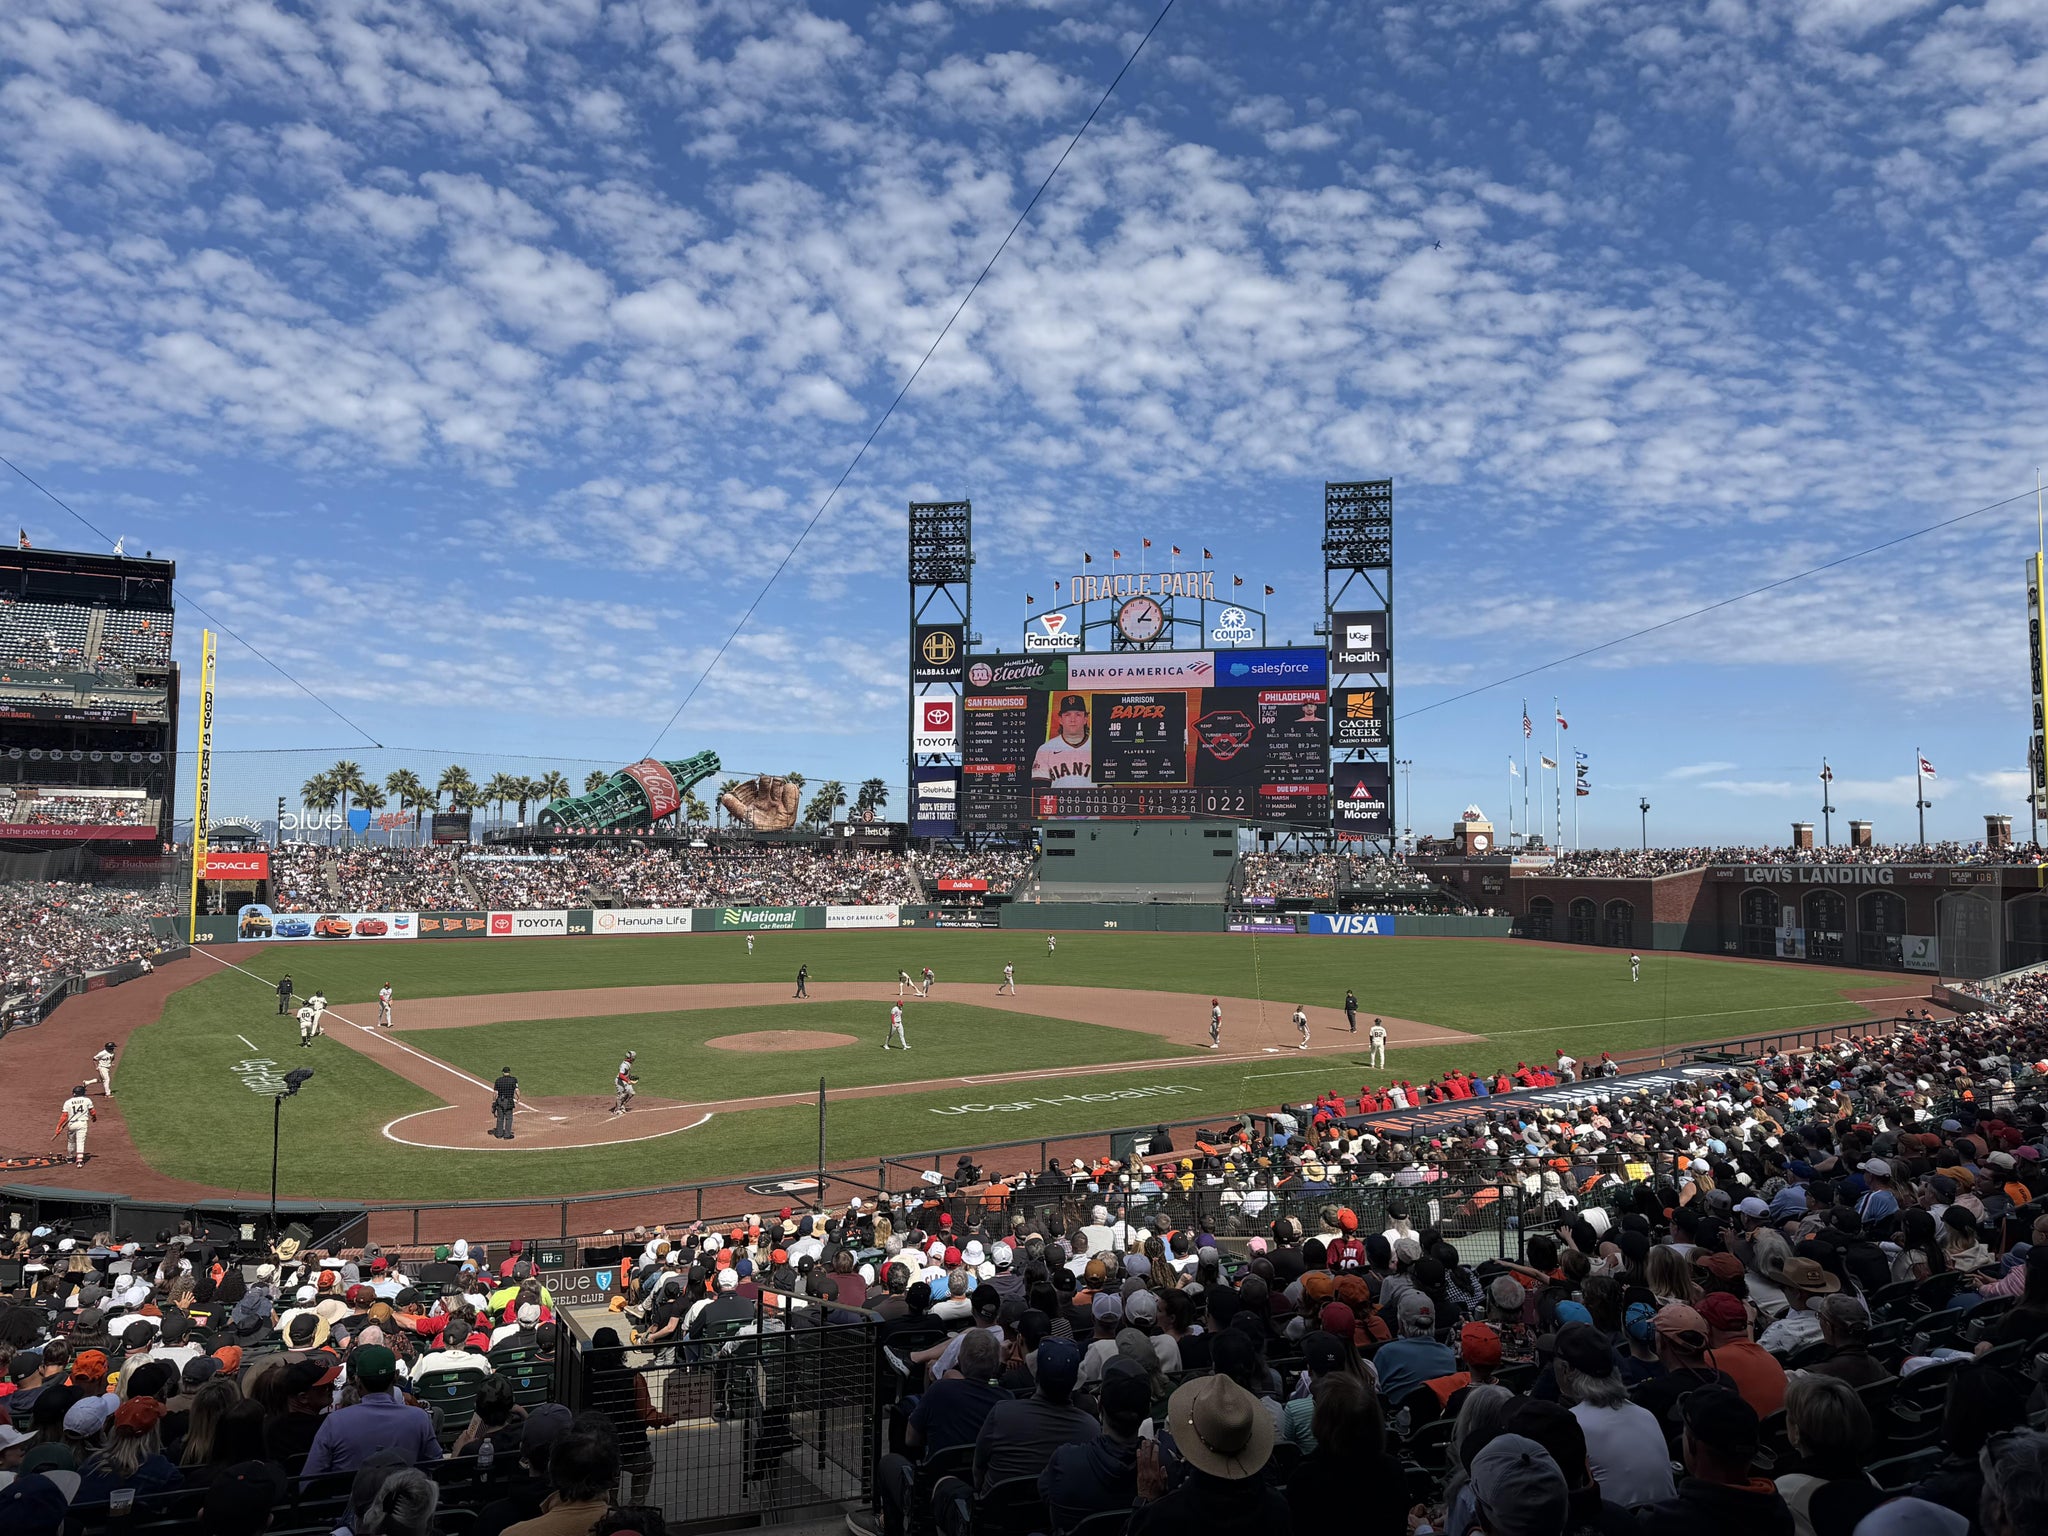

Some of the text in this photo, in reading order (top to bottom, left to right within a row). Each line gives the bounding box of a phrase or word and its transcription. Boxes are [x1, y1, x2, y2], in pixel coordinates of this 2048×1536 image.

[1072, 571, 1215, 605] ORACLE PARK
[1214, 629, 1251, 642] coupa
[1349, 632, 1369, 642] UCSF
[1027, 635, 1081, 649] Fanatics
[1339, 651, 1380, 663] Health
[2030, 618, 2041, 694] CHIKIN
[917, 668, 945, 676] HABBAS
[993, 663, 1045, 682] Electric
[1072, 666, 1184, 677] BANK OF AMERICA
[1251, 662, 1309, 676] salesforce
[1122, 696, 1154, 704] HARRISON
[1265, 692, 1320, 702] PHILADELPHIA
[968, 698, 1024, 707] SAN FRANCISCO
[203, 692, 213, 729] ROOT
[1110, 705, 1166, 719] BADER
[1160, 722, 1165, 730] 3
[1339, 720, 1382, 728] CACHE
[1340, 728, 1380, 737] CREEK
[917, 738, 959, 746] TOYOTA
[201, 751, 211, 779] THA
[2035, 735, 2046, 788] FARE
[1049, 762, 1091, 781] GIANT
[922, 785, 953, 794] StubHub
[1277, 785, 1309, 793] DUE UP PHI
[919, 803, 933, 811] 100%
[1207, 796, 1244, 811] 0 2 2
[1337, 800, 1385, 810] Benjamin
[199, 783, 209, 840] CHIKIN
[917, 812, 936, 820] GIANTS
[1344, 810, 1378, 820] Moore
[280, 808, 343, 831] blue
[22, 828, 48, 836] power
[62, 827, 78, 835] do?
[1338, 832, 1363, 842] Coors
[122, 860, 172, 870] Budweiser
[206, 861, 259, 870] ORACLE
[1799, 867, 1894, 885] LANDING
[953, 881, 973, 889] Adobe
[617, 915, 687, 927] Hanwha Life
[740, 909, 796, 923] National
[517, 918, 563, 928] TOYOTA
[902, 919, 915, 927] 399
[1104, 920, 1118, 928] 391
[1325, 915, 1378, 934] VISA
[569, 925, 586, 933] 354
[195, 933, 214, 942] 339
[1724, 942, 1737, 950] 365
[1034, 1084, 1203, 1106] Health
[72, 1105, 84, 1114] 14
[928, 1101, 1037, 1115] UCSF
[542, 1255, 553, 1263] 112
[545, 1274, 591, 1292] blue
[552, 1293, 604, 1306] FIELD CLUB
